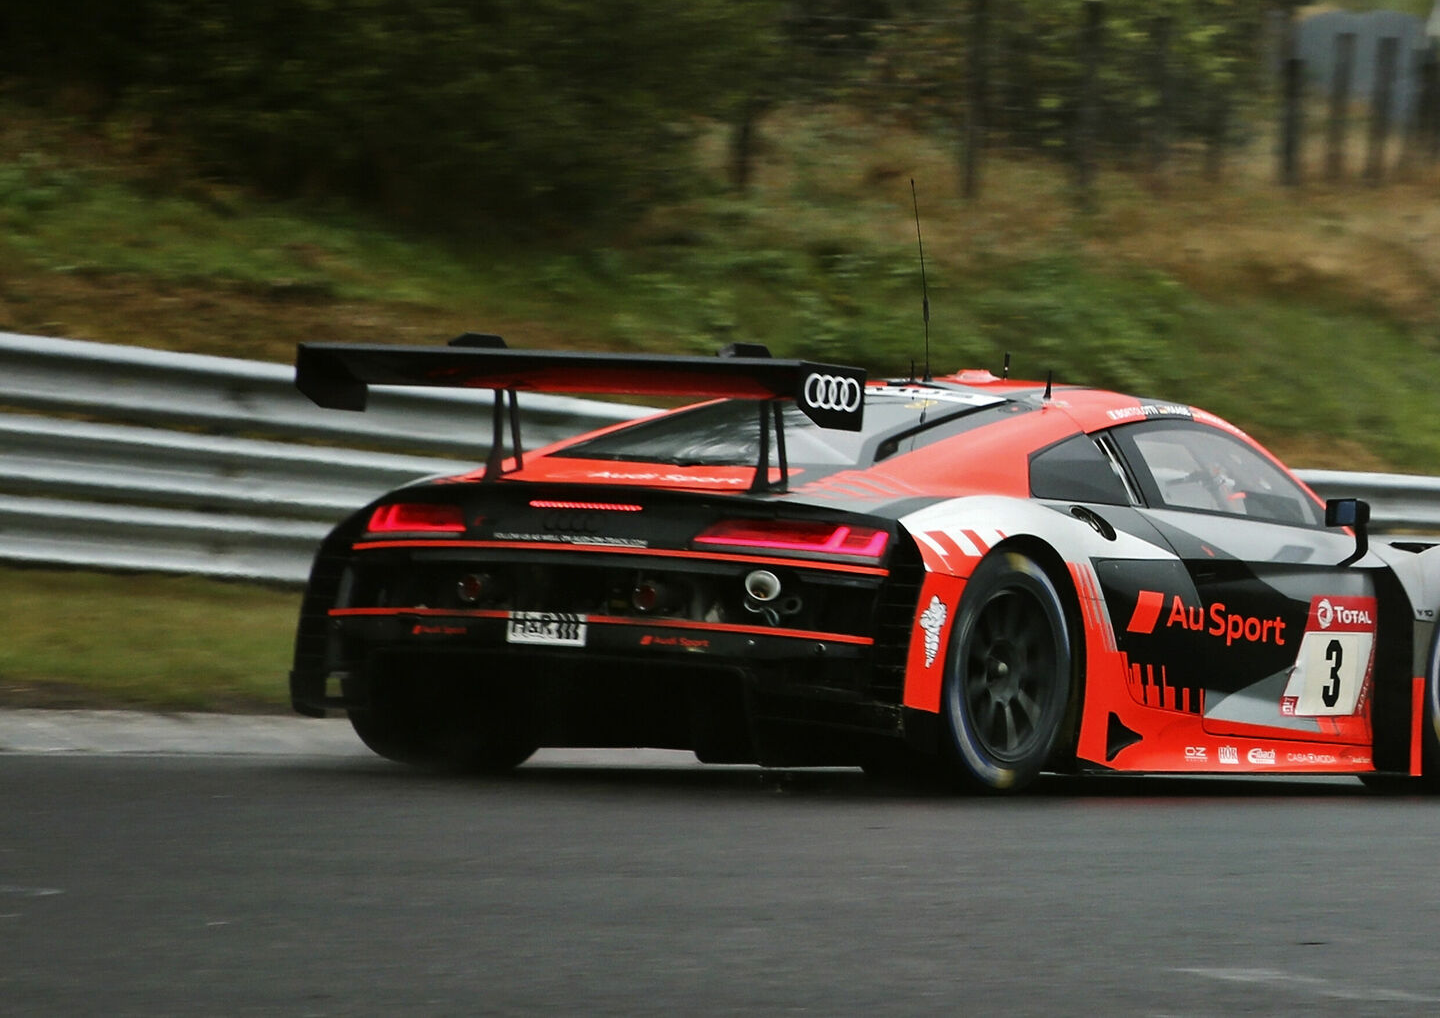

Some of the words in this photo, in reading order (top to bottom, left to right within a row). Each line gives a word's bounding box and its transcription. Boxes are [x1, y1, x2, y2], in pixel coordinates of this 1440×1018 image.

[1166, 595, 1204, 631] Au
[1209, 602, 1286, 646] Sport
[1334, 606, 1372, 625] TOTAL
[1322, 639, 1343, 708] 3
